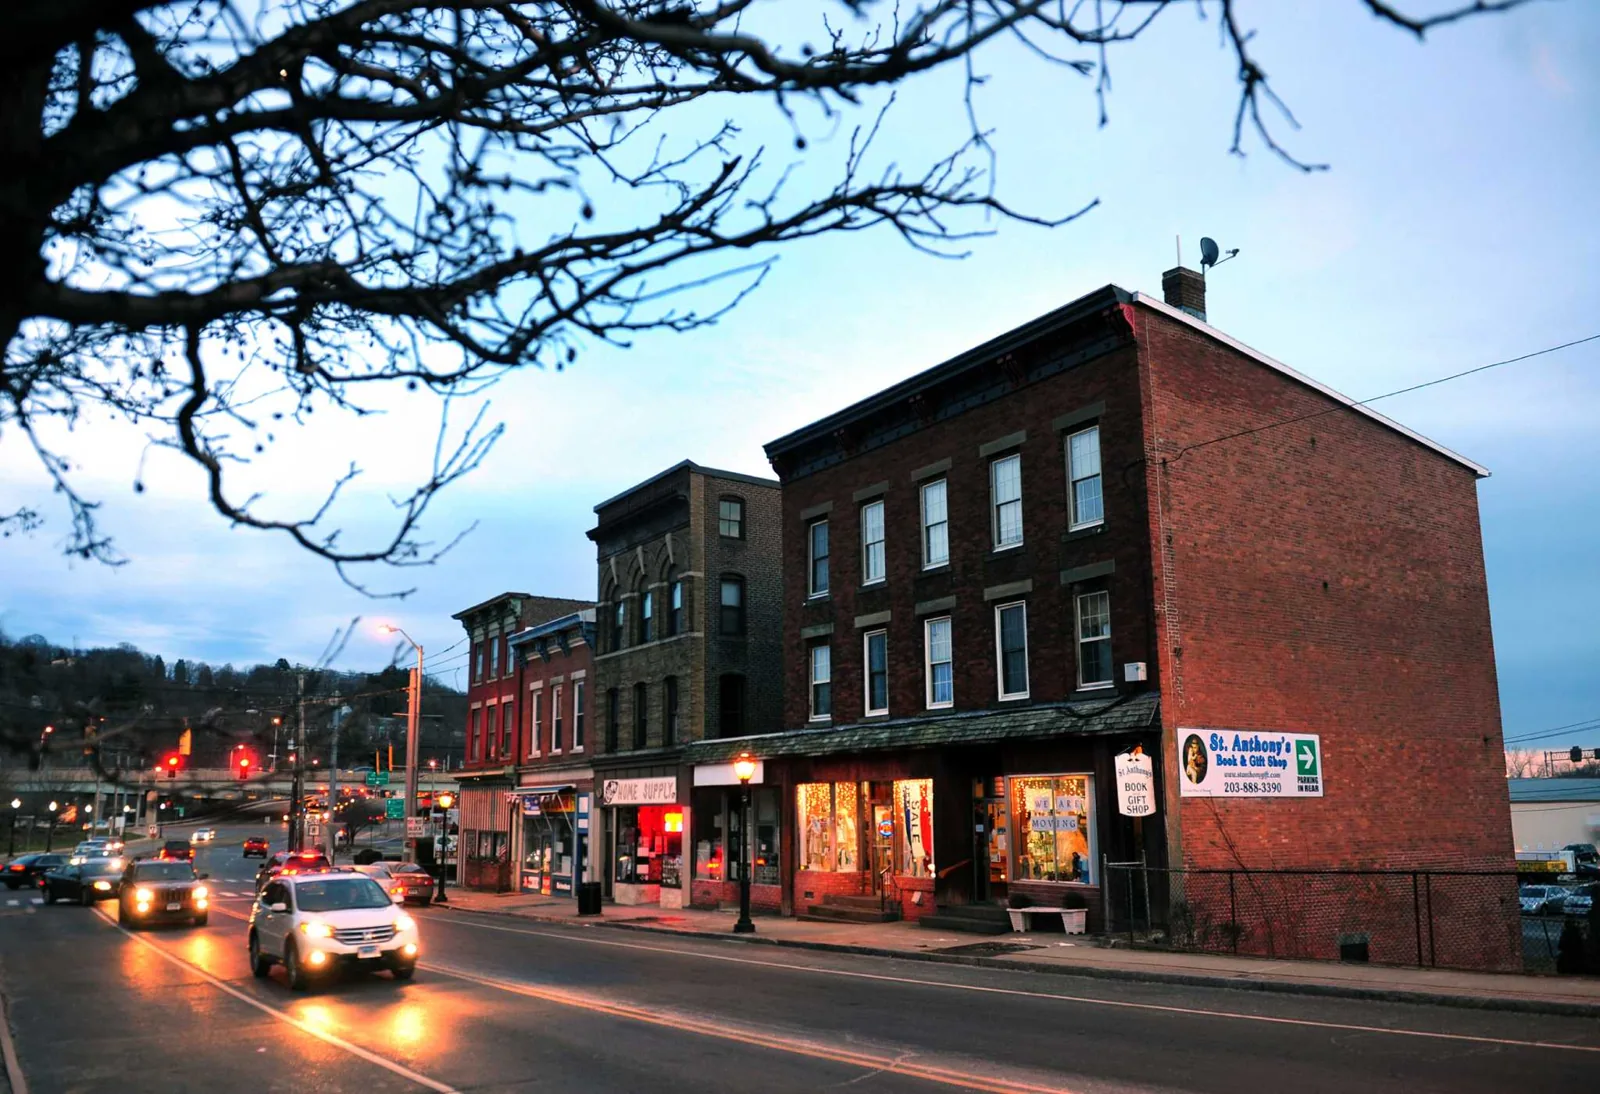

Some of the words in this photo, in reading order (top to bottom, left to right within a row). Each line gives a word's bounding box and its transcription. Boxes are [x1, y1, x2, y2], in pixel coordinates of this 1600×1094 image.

[1209, 732, 1228, 751] St.
[1232, 734, 1291, 756] Anthony's
[1216, 754, 1238, 766] Book
[1240, 755, 1247, 766] &
[1249, 755, 1266, 767] Gift
[1268, 756, 1287, 769] Shop
[1297, 776, 1319, 784] PARKING
[617, 783, 638, 801] HOME
[1124, 782, 1148, 792] BOOK
[1224, 781, 1282, 793] 203-888-3390
[1035, 799, 1049, 808] WE
[1058, 800, 1080, 808] ARE
[1127, 795, 1147, 805] GIFT
[1126, 804, 1150, 814] SHOP
[911, 800, 921, 843] SALE
[1032, 819, 1076, 828] MOVING
